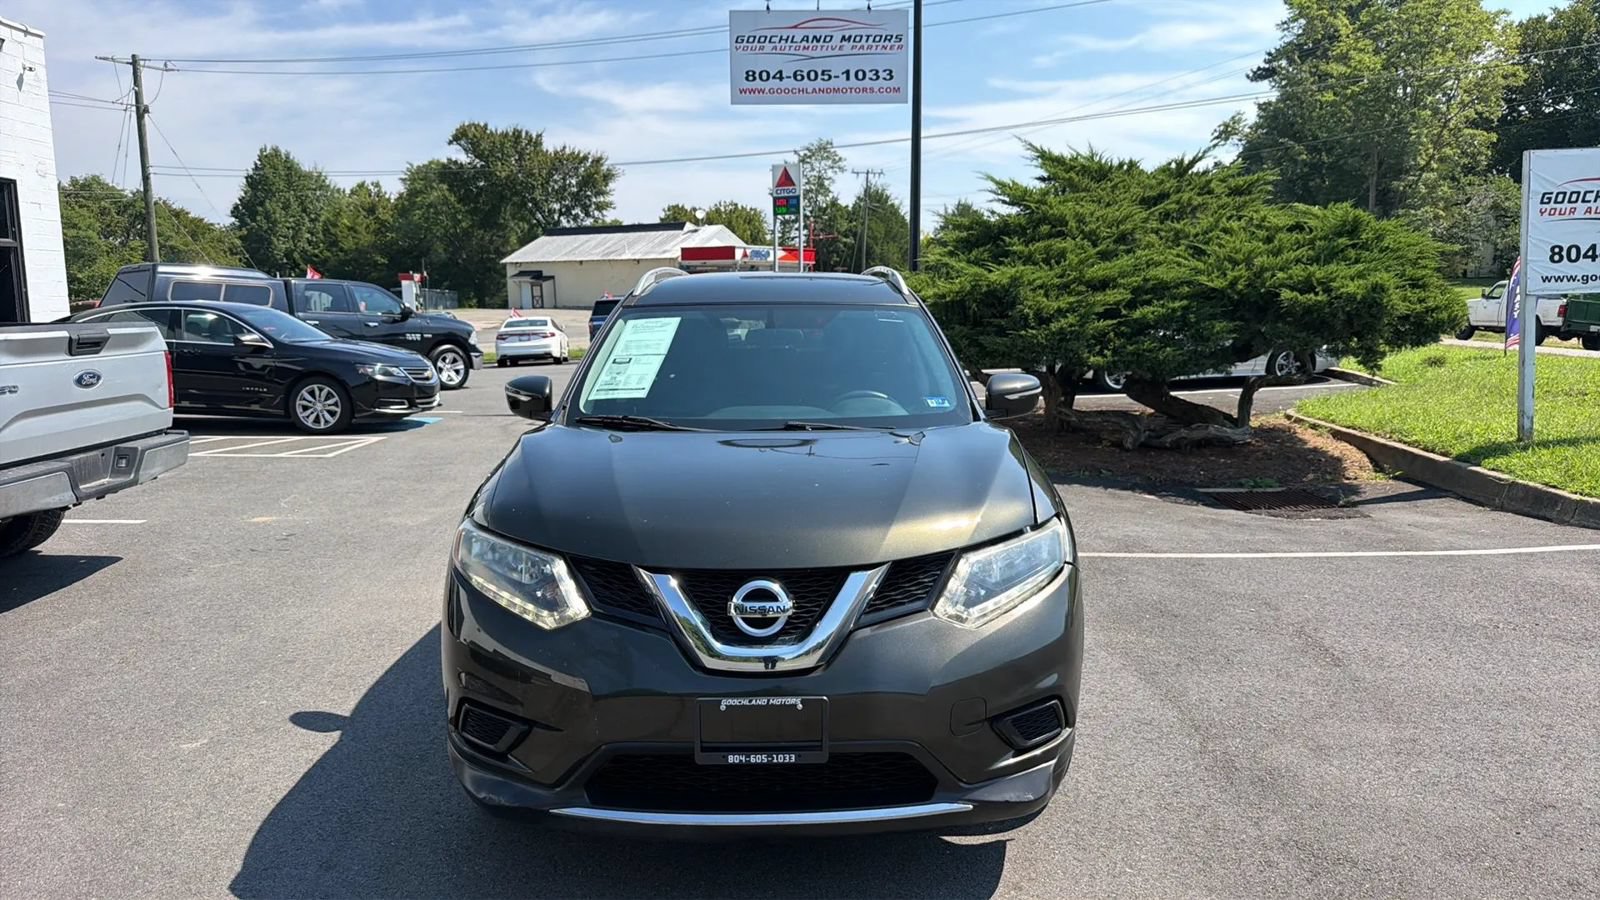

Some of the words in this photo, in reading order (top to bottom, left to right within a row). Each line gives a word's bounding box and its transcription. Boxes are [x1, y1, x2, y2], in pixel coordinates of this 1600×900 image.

[734, 34, 834, 44] GOOCHLAND
[840, 34, 904, 44] MOTORS
[744, 69, 895, 82] 804-605-1033
[738, 86, 901, 95] WWW.GOOCHLANDMOTORS.COM
[1539, 207, 1577, 217] YOUR
[1548, 243, 1600, 264] 804
[82, 373, 98, 385] Ford
[734, 603, 786, 614] NISSAN
[727, 754, 796, 763] 804-605-1033
